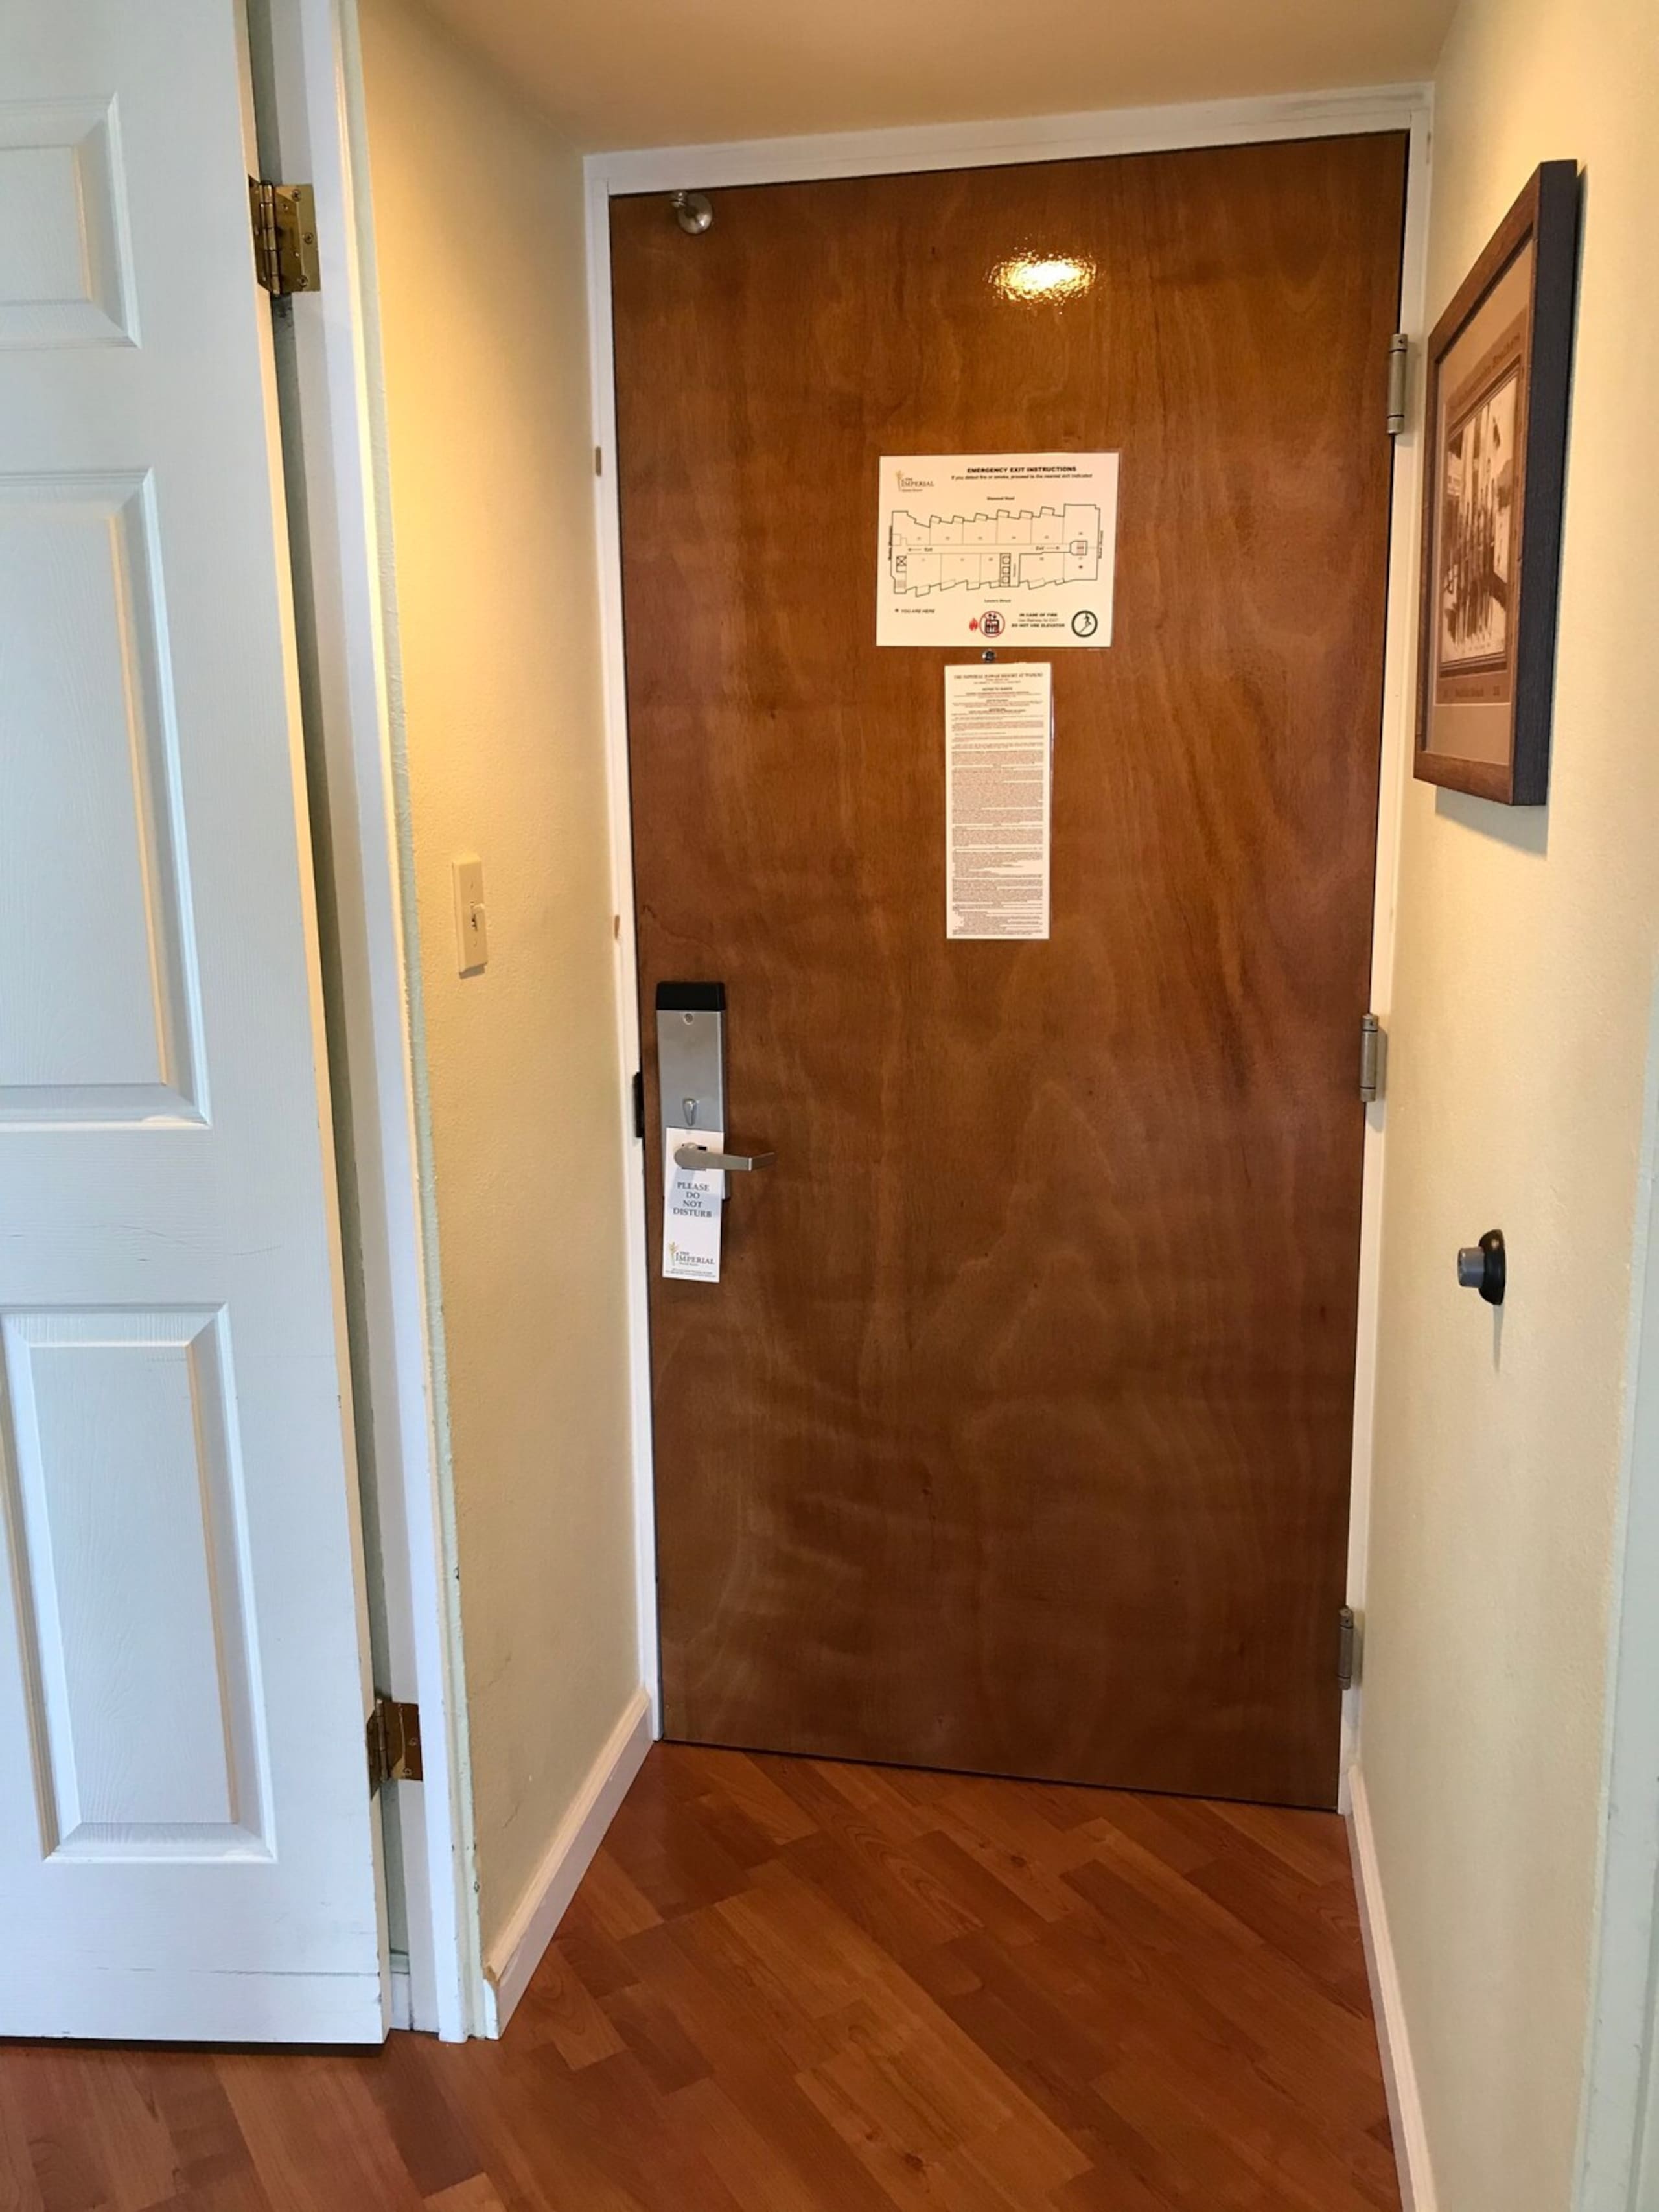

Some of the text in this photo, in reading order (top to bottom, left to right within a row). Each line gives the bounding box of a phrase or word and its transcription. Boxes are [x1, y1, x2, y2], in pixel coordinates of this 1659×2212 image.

[901, 479, 934, 487] IMPERIAL
[677, 1182, 710, 1191] PLEASE
[682, 1200, 702, 1208] NOT
[673, 1207, 712, 1218] DISTURB
[675, 1252, 715, 1265] IMPERIAL
